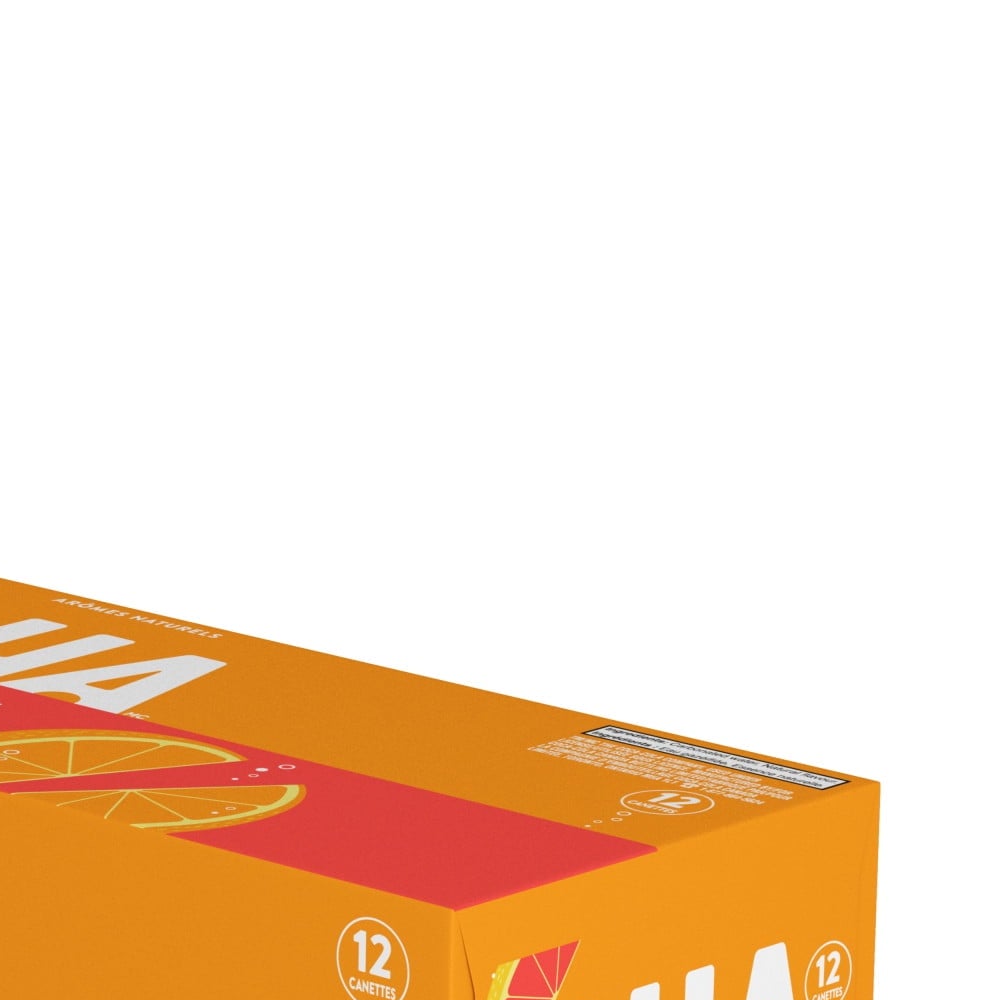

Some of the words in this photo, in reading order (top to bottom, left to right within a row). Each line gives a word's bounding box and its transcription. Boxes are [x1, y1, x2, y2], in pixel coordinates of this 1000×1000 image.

[51, 598, 130, 617] ARÔMES
[128, 615, 223, 639] NATURELS
[648, 792, 701, 808] 12
[353, 929, 392, 979] 12
[815, 950, 841, 988] 12
[348, 976, 397, 1000] CANETTES
